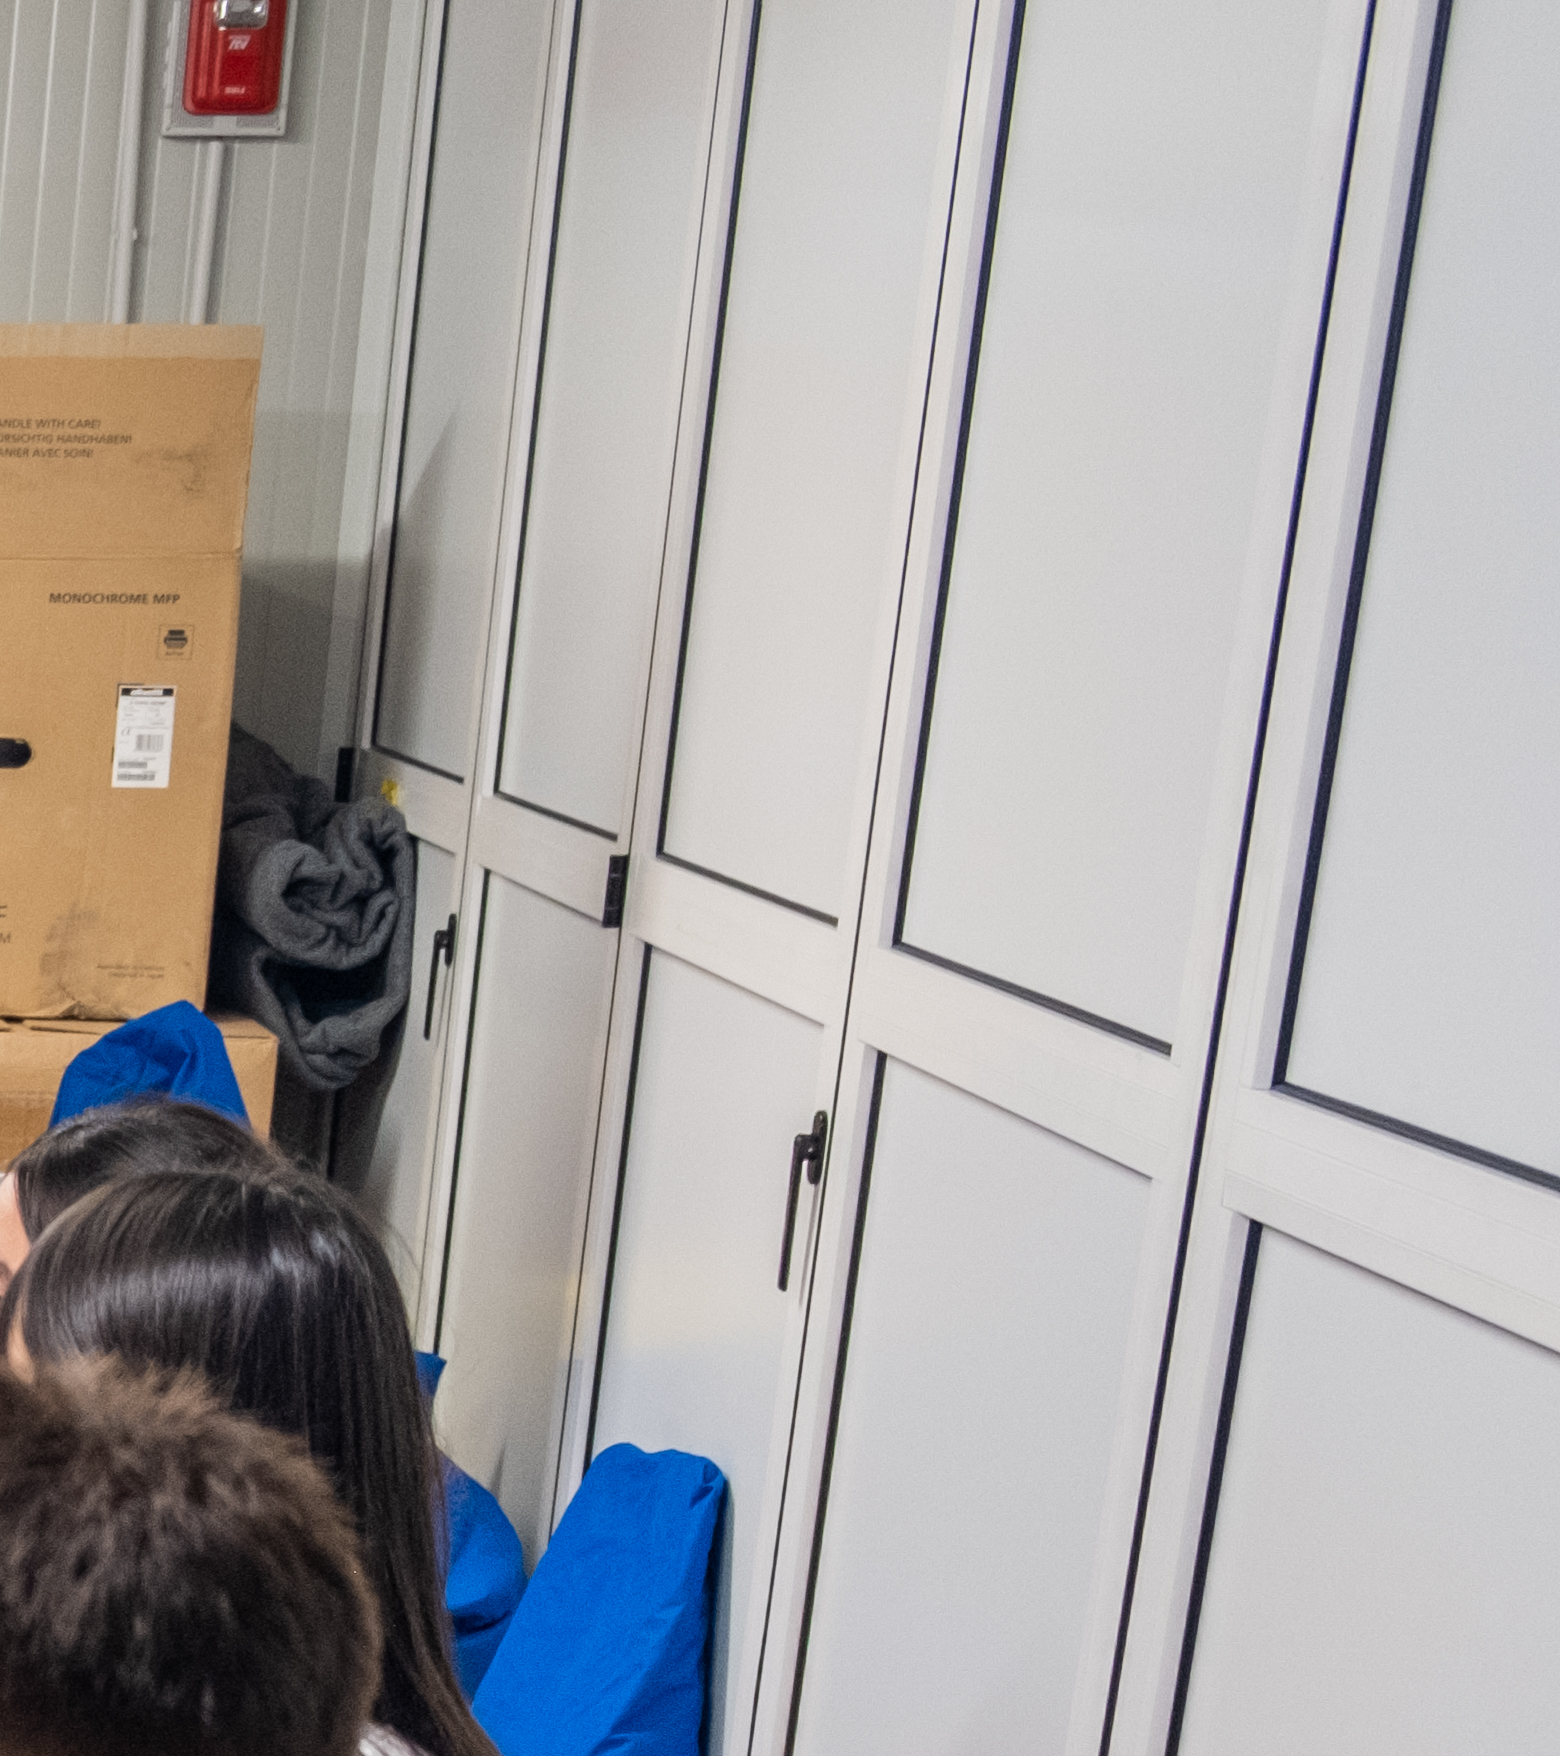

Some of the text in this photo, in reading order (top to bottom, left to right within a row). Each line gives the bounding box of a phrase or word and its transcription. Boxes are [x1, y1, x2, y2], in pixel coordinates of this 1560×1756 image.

[35, 419, 65, 429] WITH
[49, 593, 180, 604] MONOCHROME MFP
